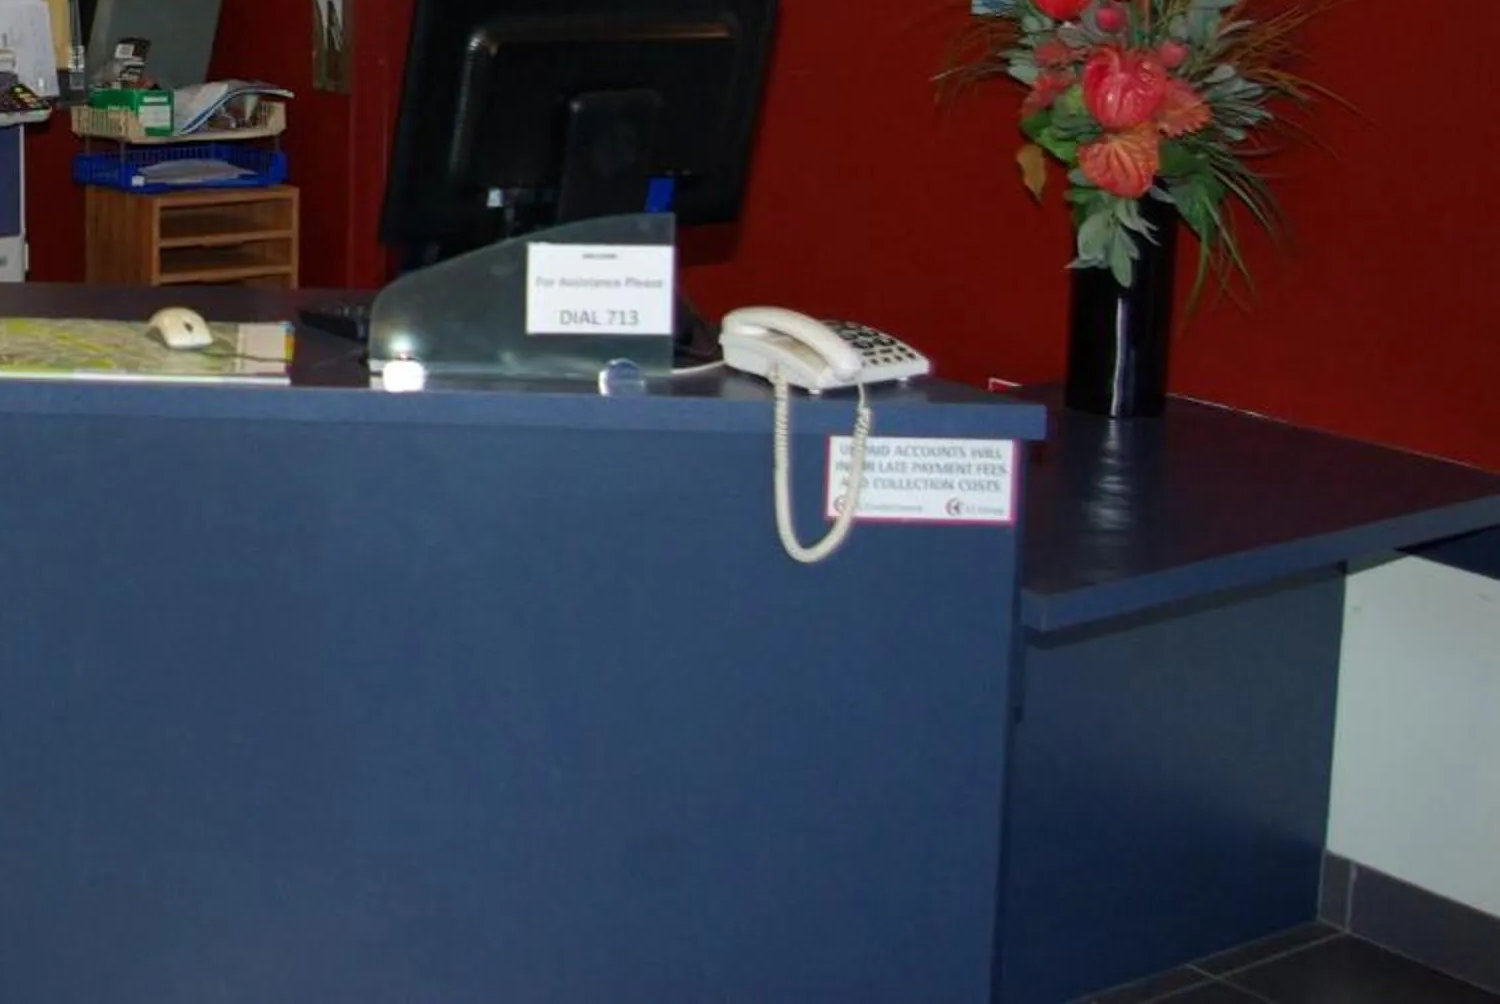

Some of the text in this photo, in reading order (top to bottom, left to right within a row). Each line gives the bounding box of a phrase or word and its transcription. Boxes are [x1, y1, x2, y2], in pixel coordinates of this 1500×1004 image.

[535, 276, 664, 288] For Assistance Please
[559, 309, 640, 326] DIAL 713
[894, 445, 967, 459] ACCOUNTS
[971, 447, 1003, 460] WILL
[879, 461, 908, 474] LATE
[911, 462, 972, 475] PAYMENT
[976, 463, 1008, 476] FEES
[873, 477, 954, 491] COLLECTION
[958, 479, 1001, 492] COSTS
